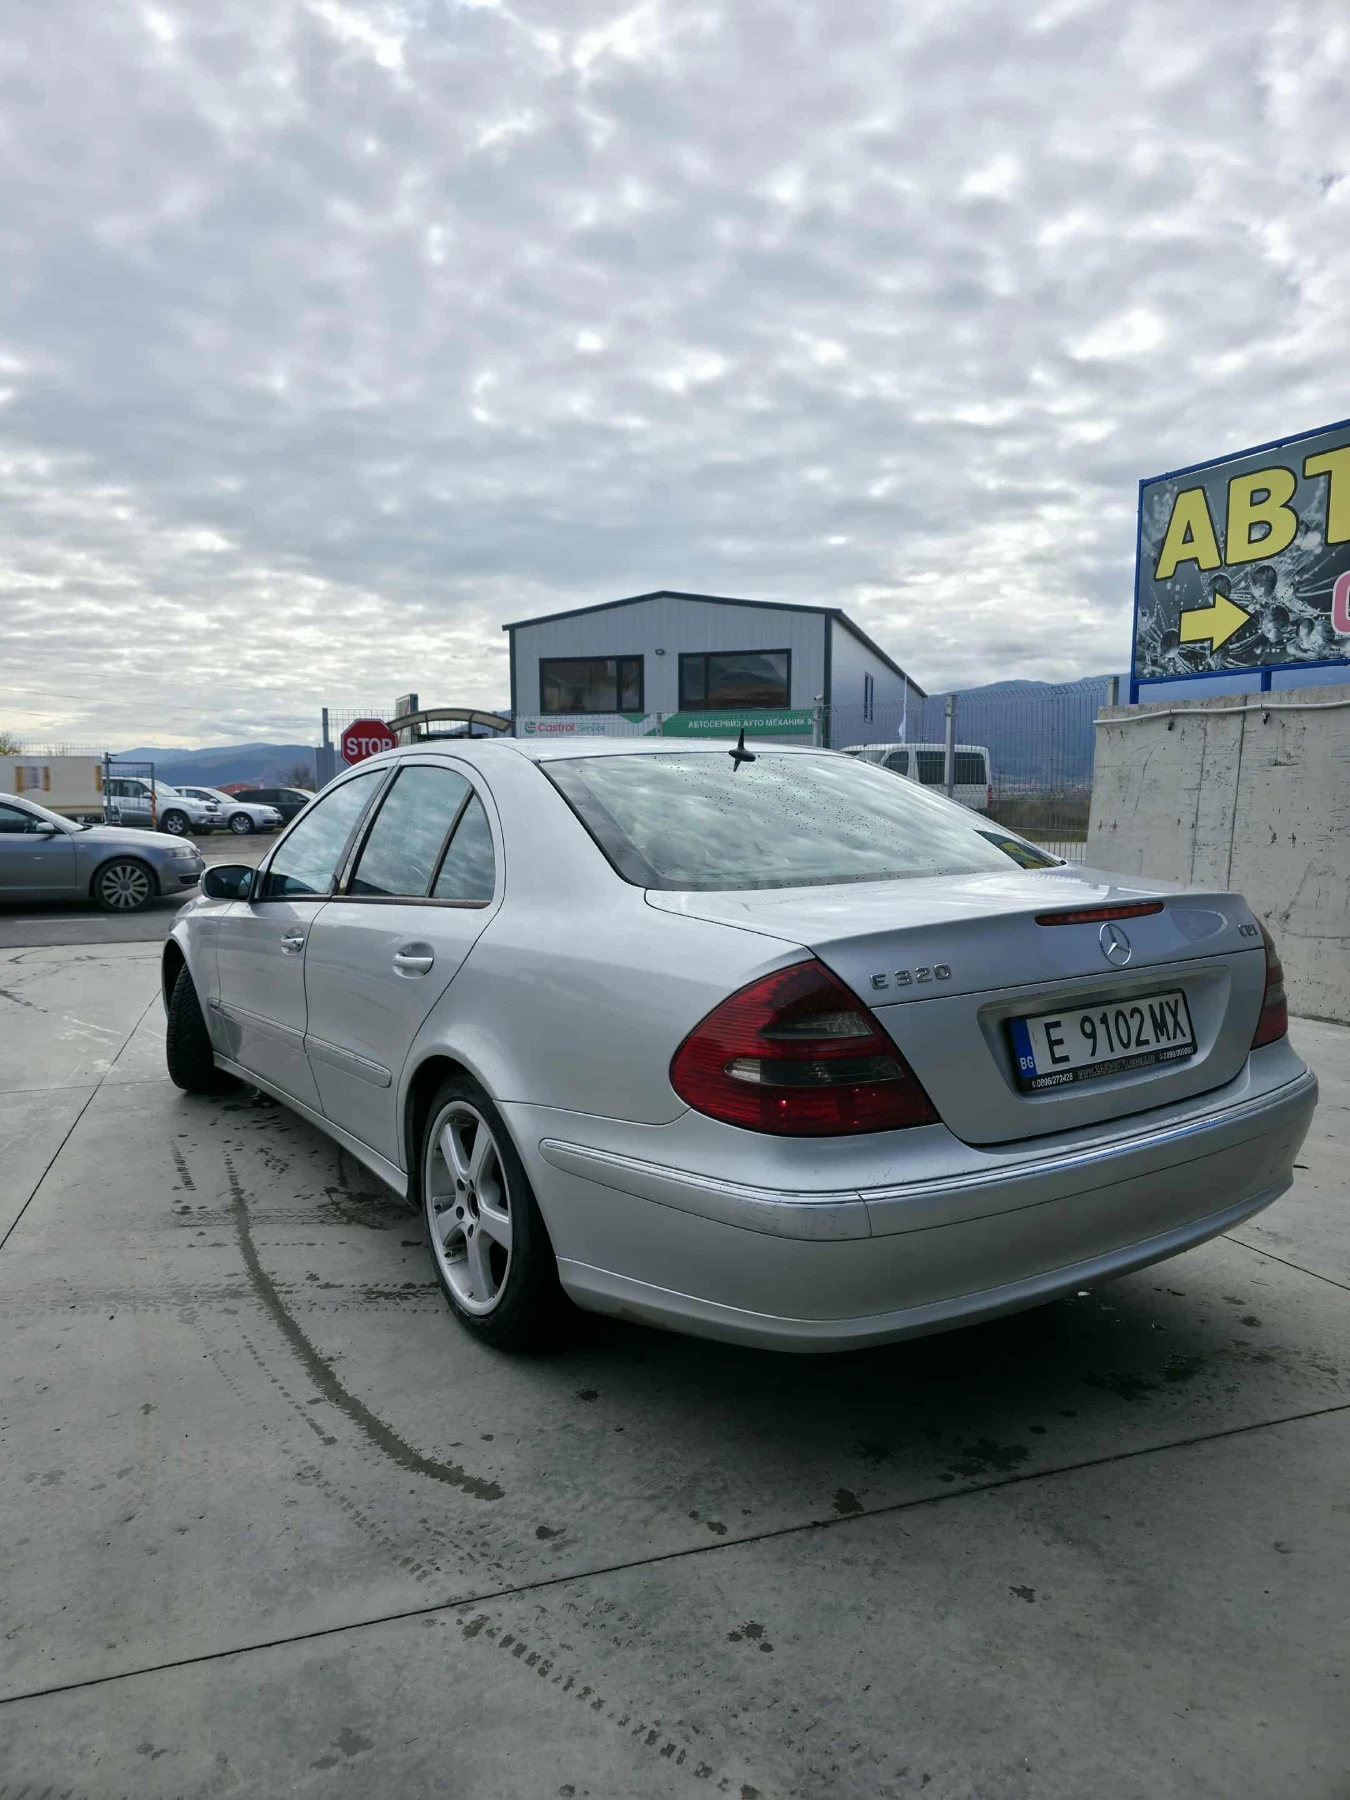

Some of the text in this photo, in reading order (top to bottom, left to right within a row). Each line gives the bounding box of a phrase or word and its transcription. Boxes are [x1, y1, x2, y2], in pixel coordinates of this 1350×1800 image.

[538, 722, 605, 732] Castrol Service
[688, 720, 741, 729] АВТОСЕРВИЗ
[743, 719, 764, 728] АУТО
[766, 718, 805, 727] МЕХАНИК
[346, 737, 393, 756] STOP
[869, 963, 952, 990] E 320
[1043, 999, 1187, 1065] E 9102 MX
[1019, 1055, 1034, 1070] BG
